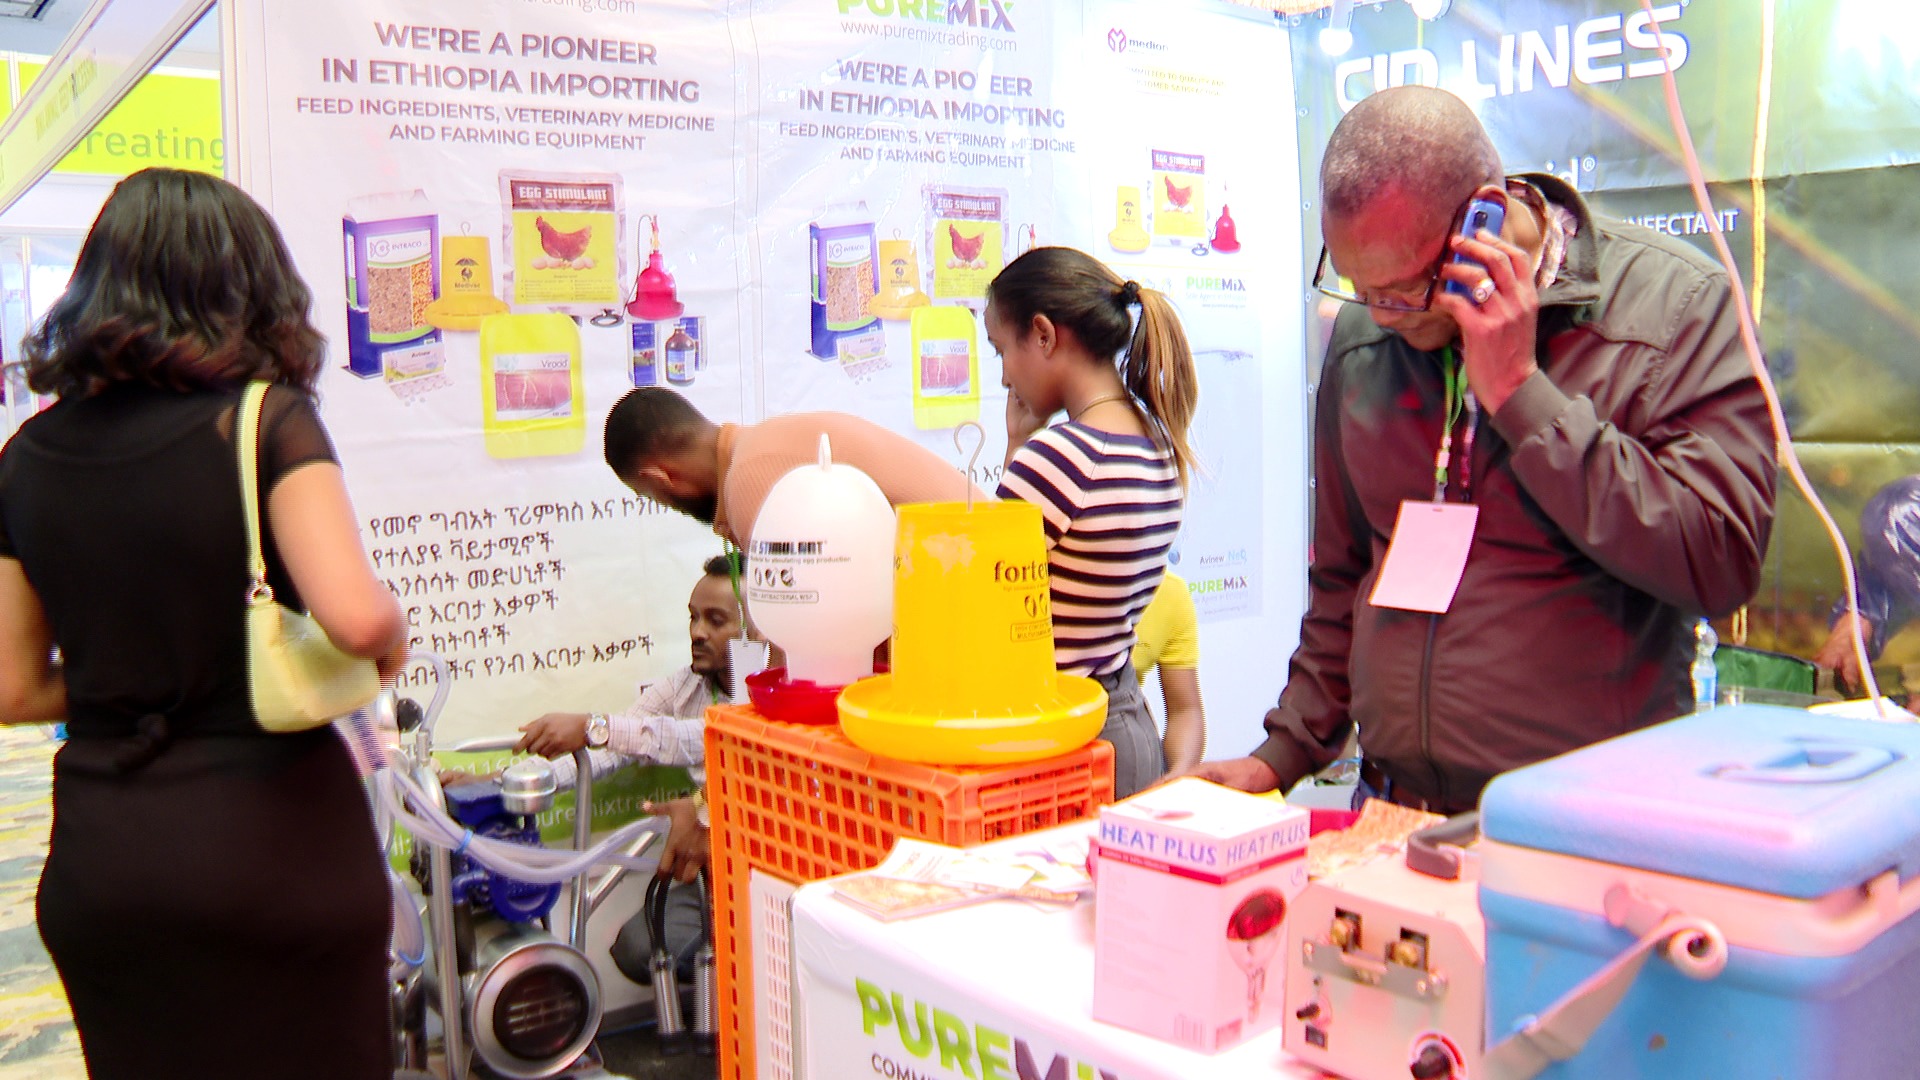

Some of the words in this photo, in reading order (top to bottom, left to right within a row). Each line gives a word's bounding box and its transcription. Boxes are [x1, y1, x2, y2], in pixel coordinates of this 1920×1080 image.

[374, 22, 481, 54] WE'RE
[488, 31, 513, 57] A
[521, 34, 658, 66] PIONEER
[841, 22, 1017, 51] www.puremixtrading.com
[1460, 4, 1690, 100] LINES
[322, 58, 358, 83] IN
[369, 60, 523, 94] ETHIOPIA
[531, 71, 700, 103] IMPORTING
[836, 59, 908, 86] WE'RE
[911, 67, 929, 89] A
[934, 69, 1033, 97] PIOEER
[297, 97, 354, 114] FEED
[360, 99, 500, 124] INGREDIENTS,
[505, 107, 623, 128] VETERINARY
[628, 113, 715, 131] MEDICINE
[799, 89, 824, 111] IN
[830, 91, 938, 119] ETHIOPIA
[389, 124, 435, 141] AND
[441, 127, 530, 146] FARMING
[536, 131, 646, 150] EQUIPMENT
[779, 121, 819, 137] FEED
[76, 127, 225, 170] reating
[840, 146, 874, 160] AND
[950, 151, 1025, 168] EQUIPMENT
[519, 186, 541, 199] EGG
[1623, 209, 1740, 236] FECTANT
[590, 499, 615, 520] እና
[379, 571, 459, 598] እንስሳት
[1101, 821, 1159, 852] HEAT
[1164, 836, 1217, 866] PLUS
[1226, 833, 1268, 865] HEAT
[1271, 822, 1306, 849] PLUS
[855, 976, 1120, 1080] PUREM
